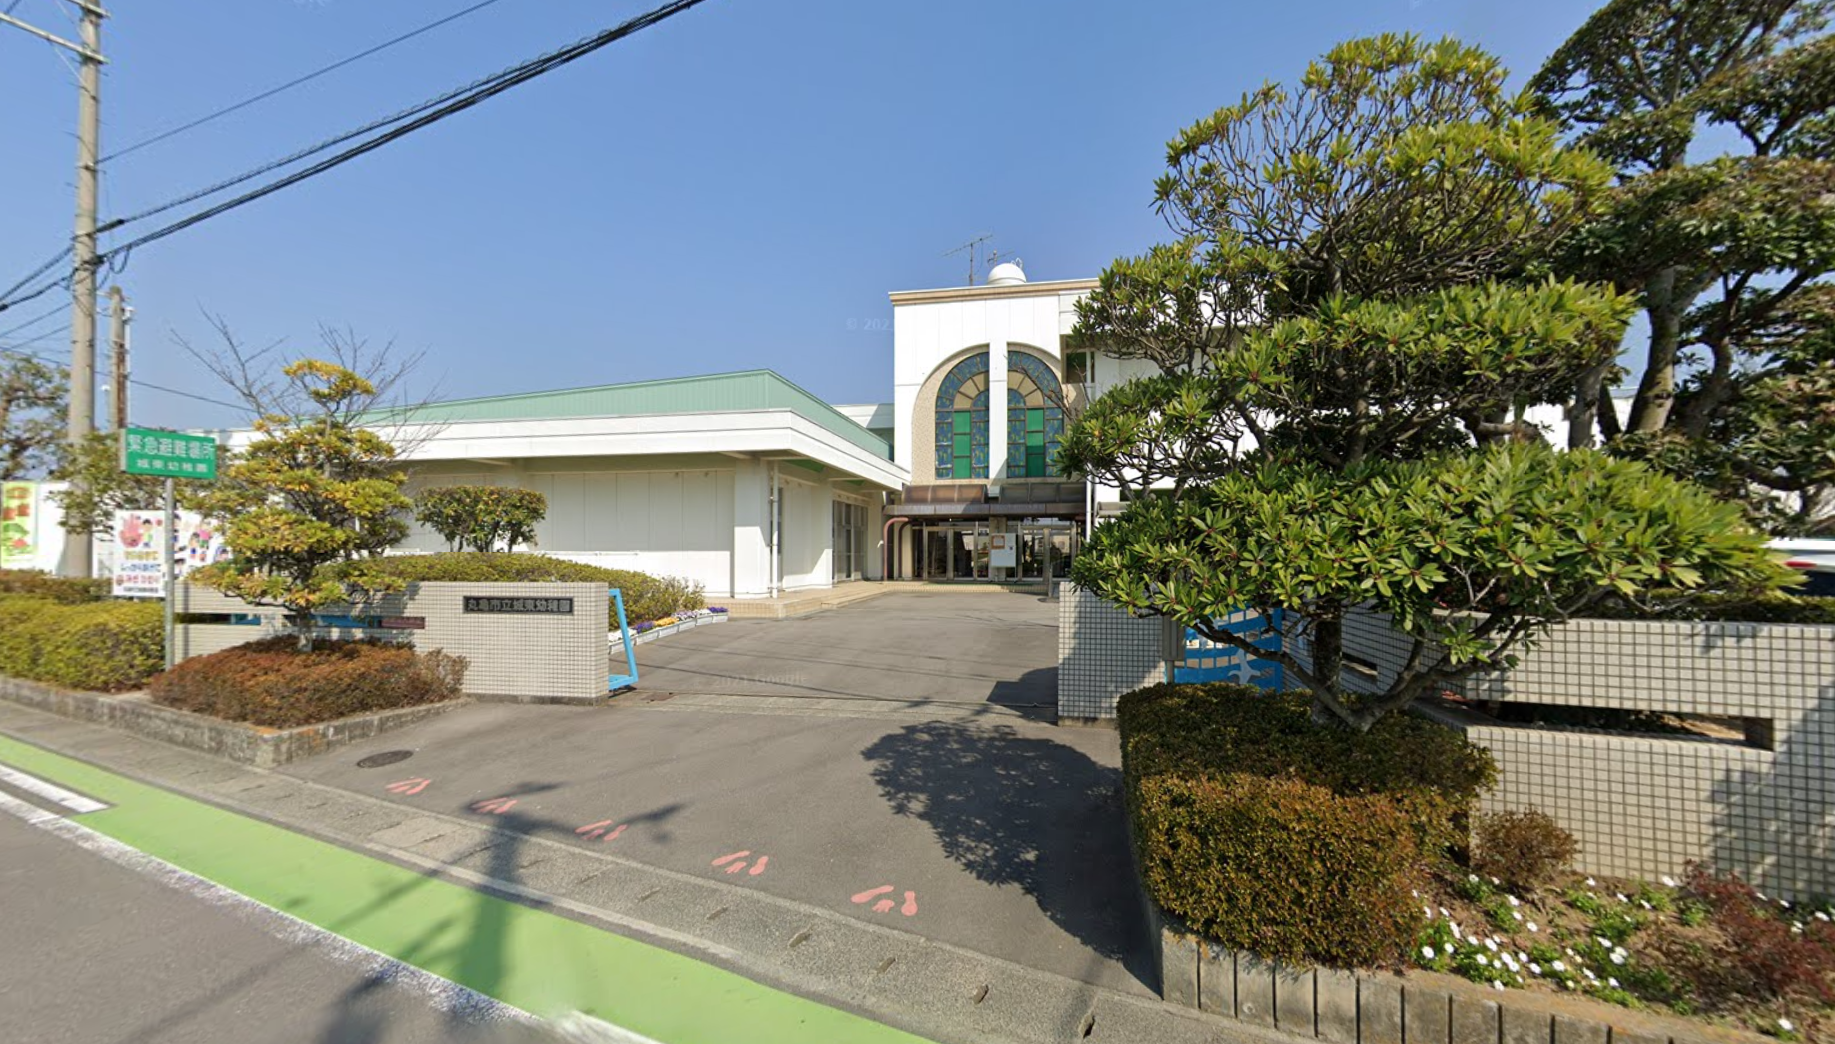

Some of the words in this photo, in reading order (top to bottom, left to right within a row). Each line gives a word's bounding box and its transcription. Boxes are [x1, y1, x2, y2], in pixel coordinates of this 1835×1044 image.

[127, 434, 215, 460] 緊急避難場所
[137, 458, 208, 473] 城東幼稚園
[467, 598, 571, 612] 丸亀市立城東幼稚園
